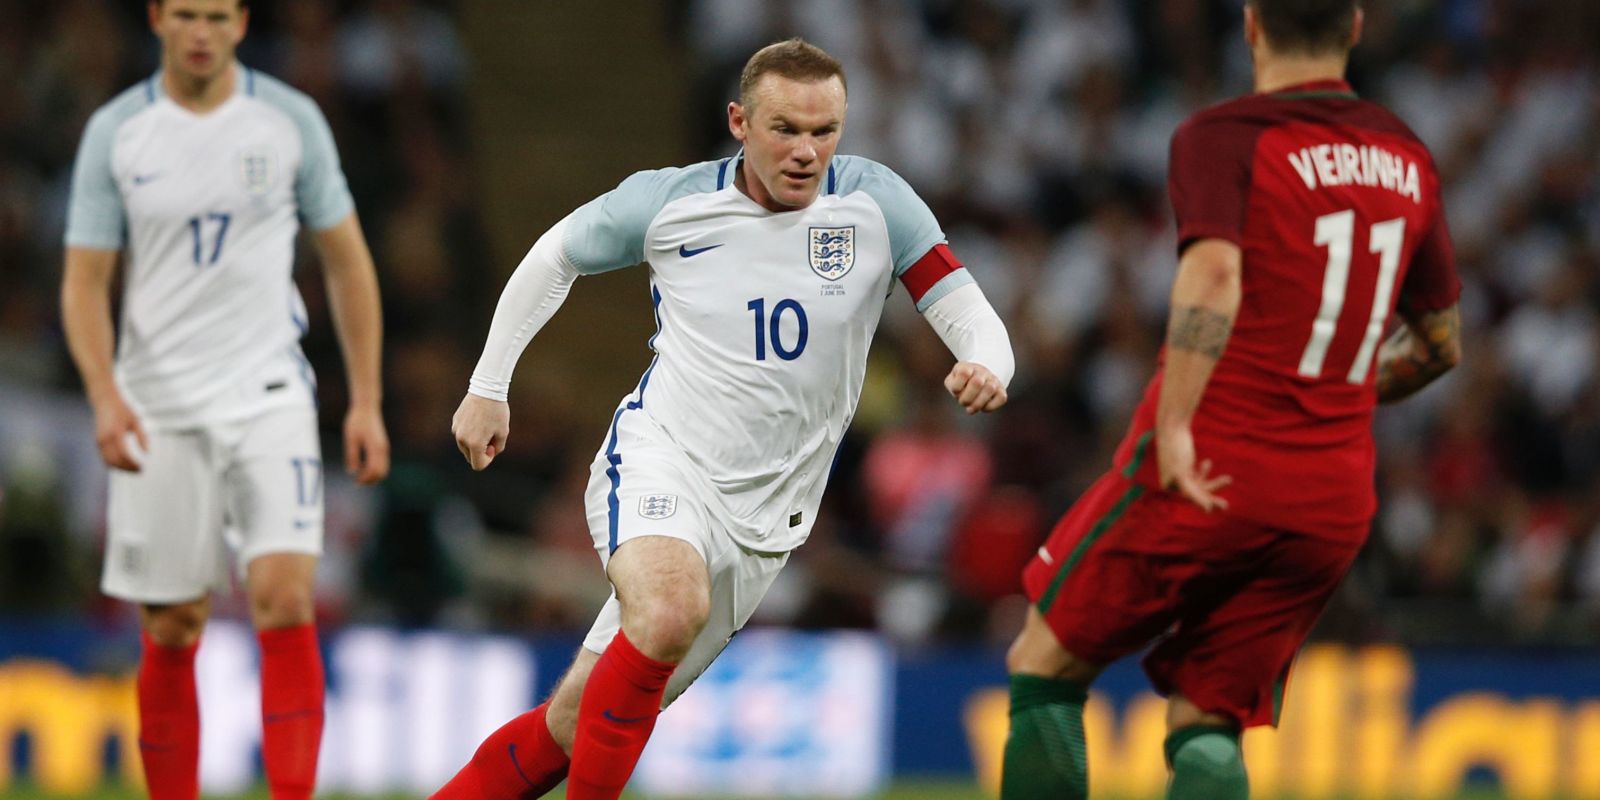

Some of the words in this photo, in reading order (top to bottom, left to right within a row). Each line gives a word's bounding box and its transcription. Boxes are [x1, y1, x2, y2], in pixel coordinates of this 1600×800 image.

[189, 212, 231, 264] 17
[1297, 208, 1406, 384] 11
[747, 297, 809, 361] 10
[291, 458, 321, 505] 17
